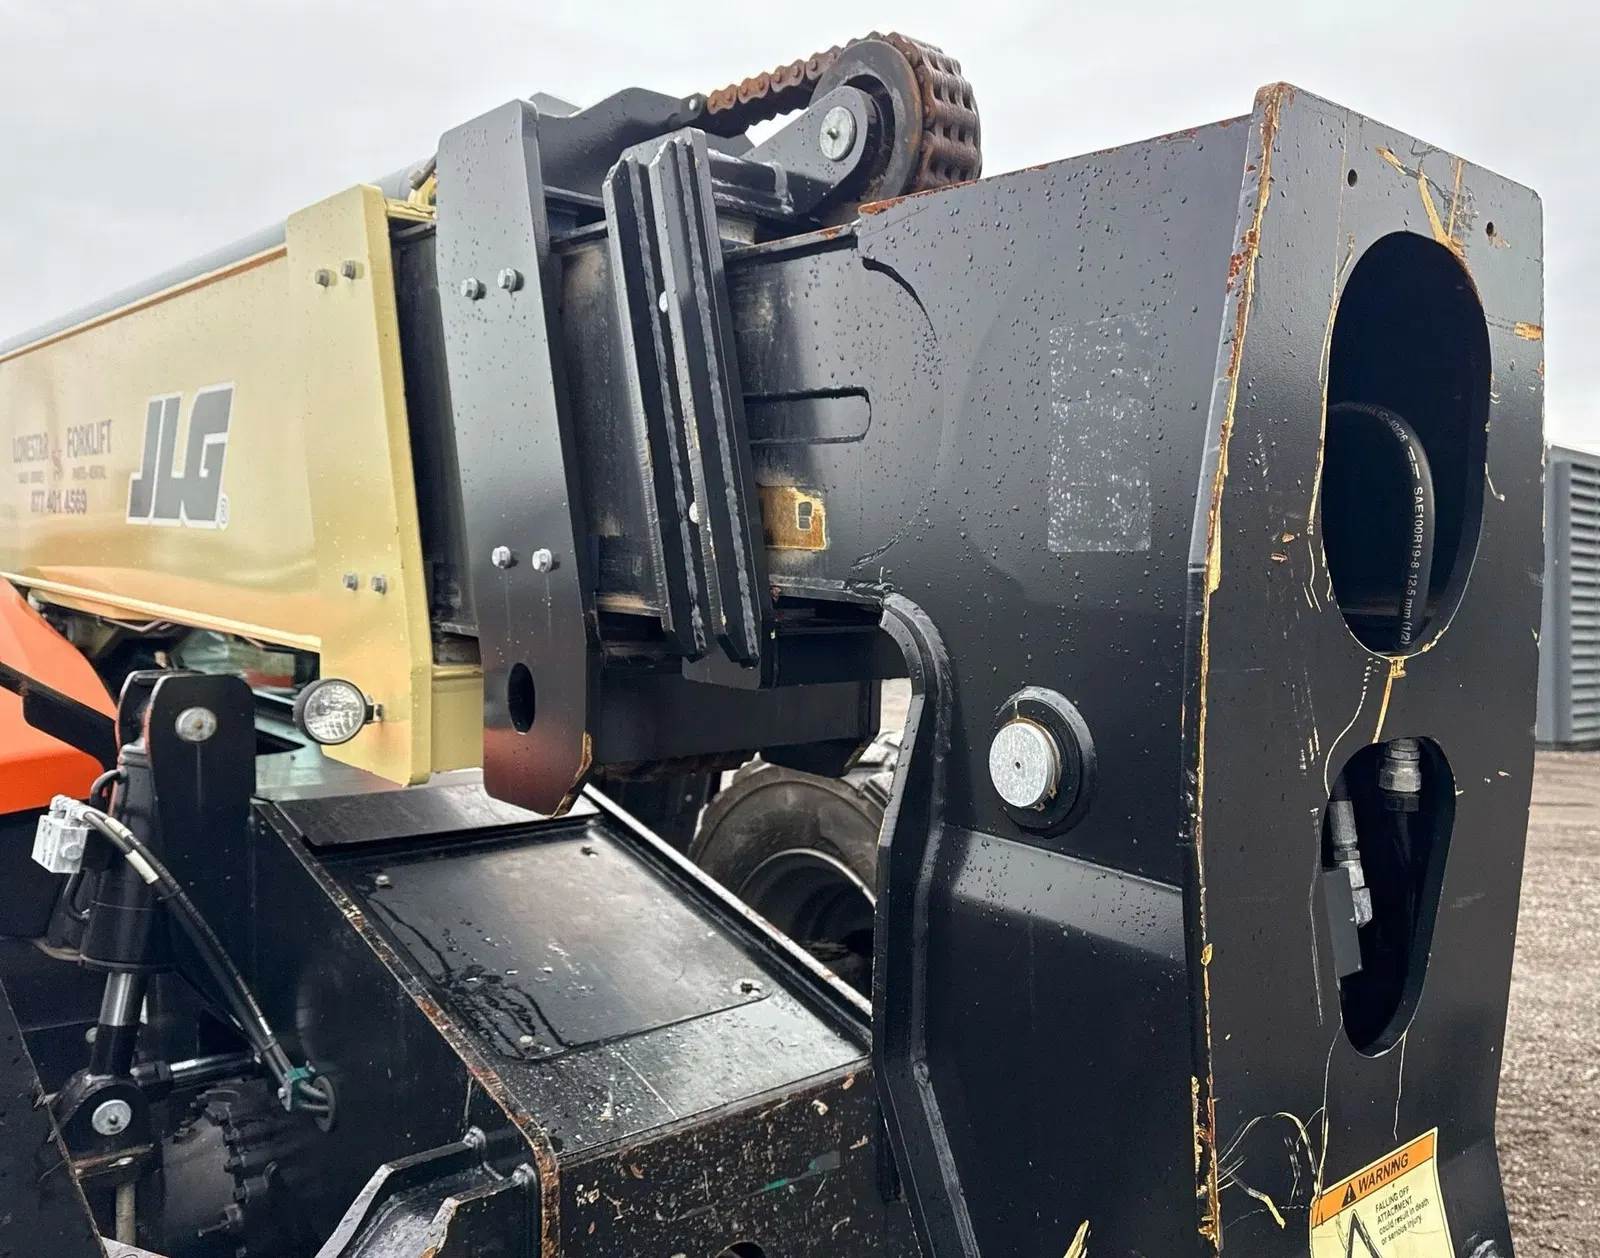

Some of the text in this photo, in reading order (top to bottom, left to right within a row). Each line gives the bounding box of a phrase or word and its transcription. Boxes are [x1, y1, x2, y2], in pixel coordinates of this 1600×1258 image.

[67, 419, 111, 458] FORKLIFT
[127, 381, 234, 528] JLG
[1410, 486, 1424, 569] SAE100R19-8
[1403, 598, 1413, 619] mm
[1400, 622, 1413, 645] (1/2)
[1358, 1152, 1409, 1194] WARNING
[1375, 1185, 1410, 1213] FALLING OFF
[1379, 1219, 1394, 1235] could
[1394, 1209, 1409, 1225] result
[1415, 1197, 1430, 1212] death
[1381, 1214, 1422, 1246] or serious injury
